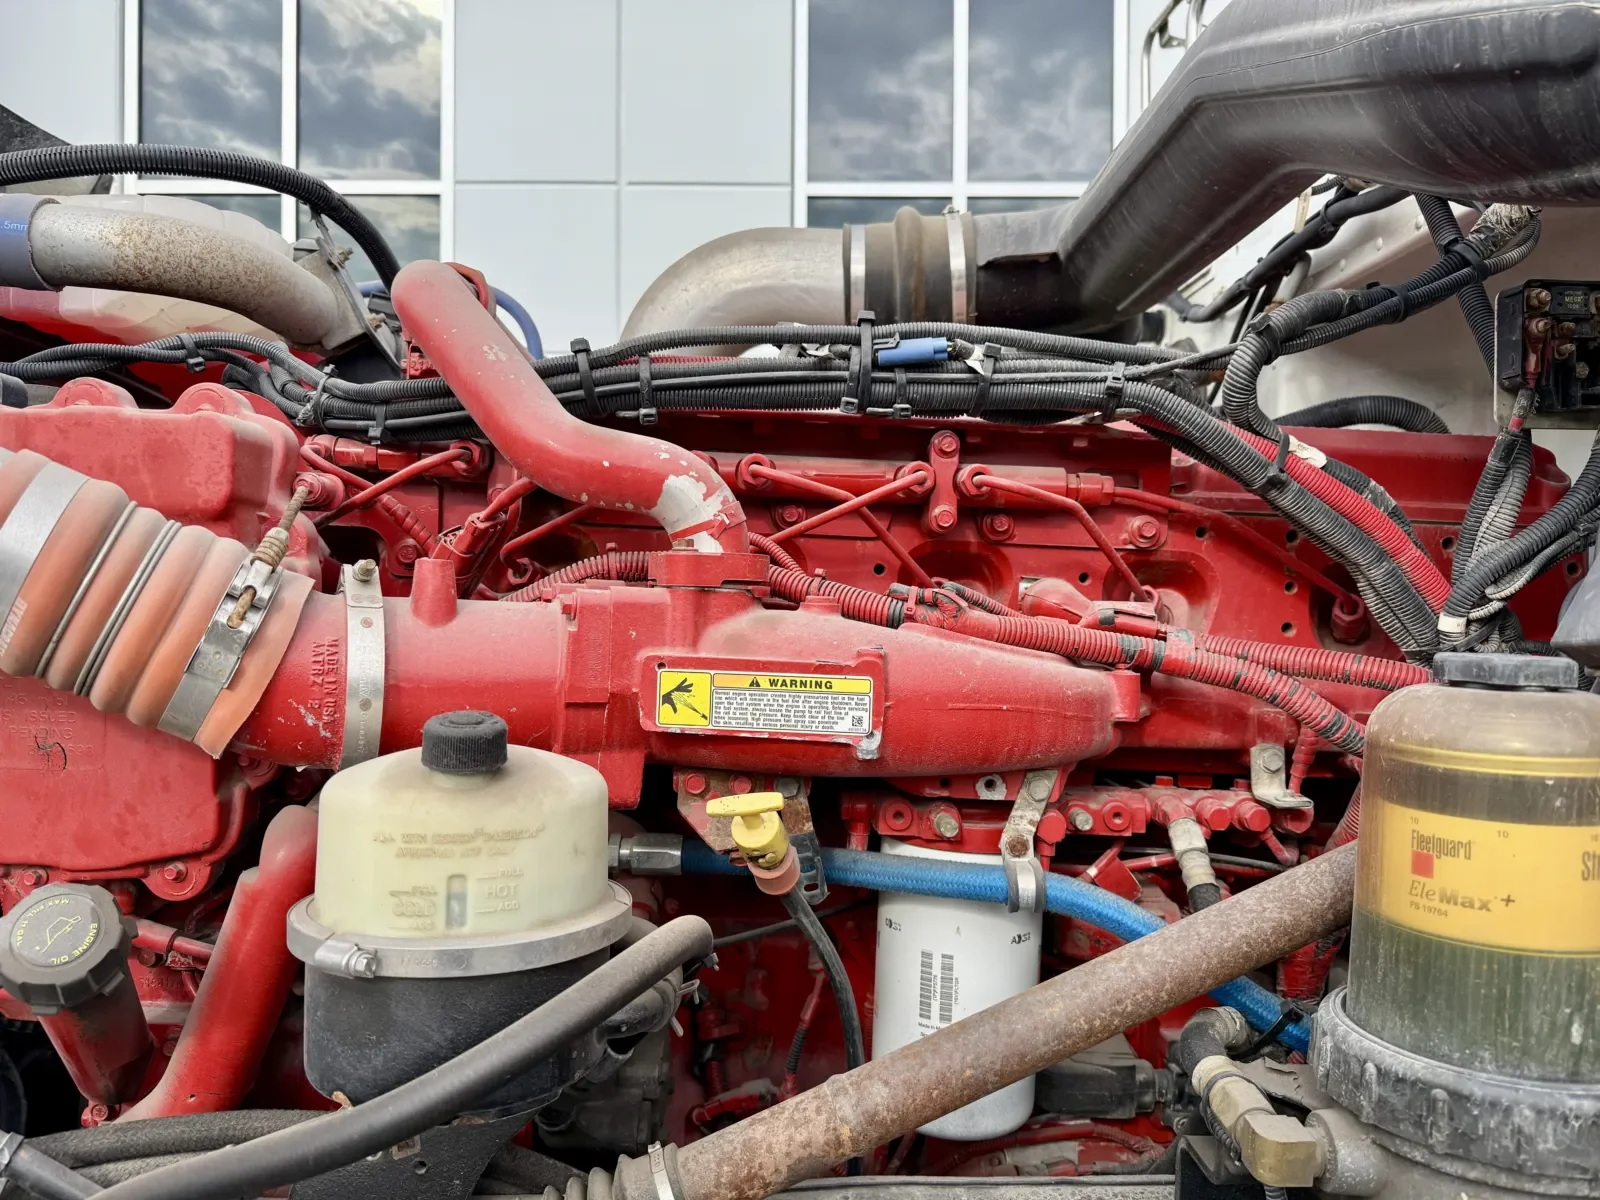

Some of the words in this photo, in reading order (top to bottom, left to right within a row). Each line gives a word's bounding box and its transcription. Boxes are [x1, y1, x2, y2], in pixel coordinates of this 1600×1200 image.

[326, 638, 340, 675] MADE
[324, 676, 338, 694] IN
[768, 678, 833, 689] WARNING
[322, 698, 338, 724] USA
[9, 725, 73, 739] PENDING
[1410, 816, 1420, 825] 10
[1497, 830, 1509, 839] 10
[1411, 829, 1472, 861] Fleetguard
[486, 883, 518, 898] HOT
[47, 898, 70, 907] MAX
[393, 901, 436, 918] COLD
[498, 901, 521, 912] ADD
[1409, 901, 1420, 911] FS
[1422, 903, 1448, 918] 19764
[27, 905, 45, 917] FILL
[16, 929, 24, 947] GAL
[71, 923, 98, 957] ENGINE
[50, 955, 69, 965] OIL
[918, 1021, 930, 1029] Made
